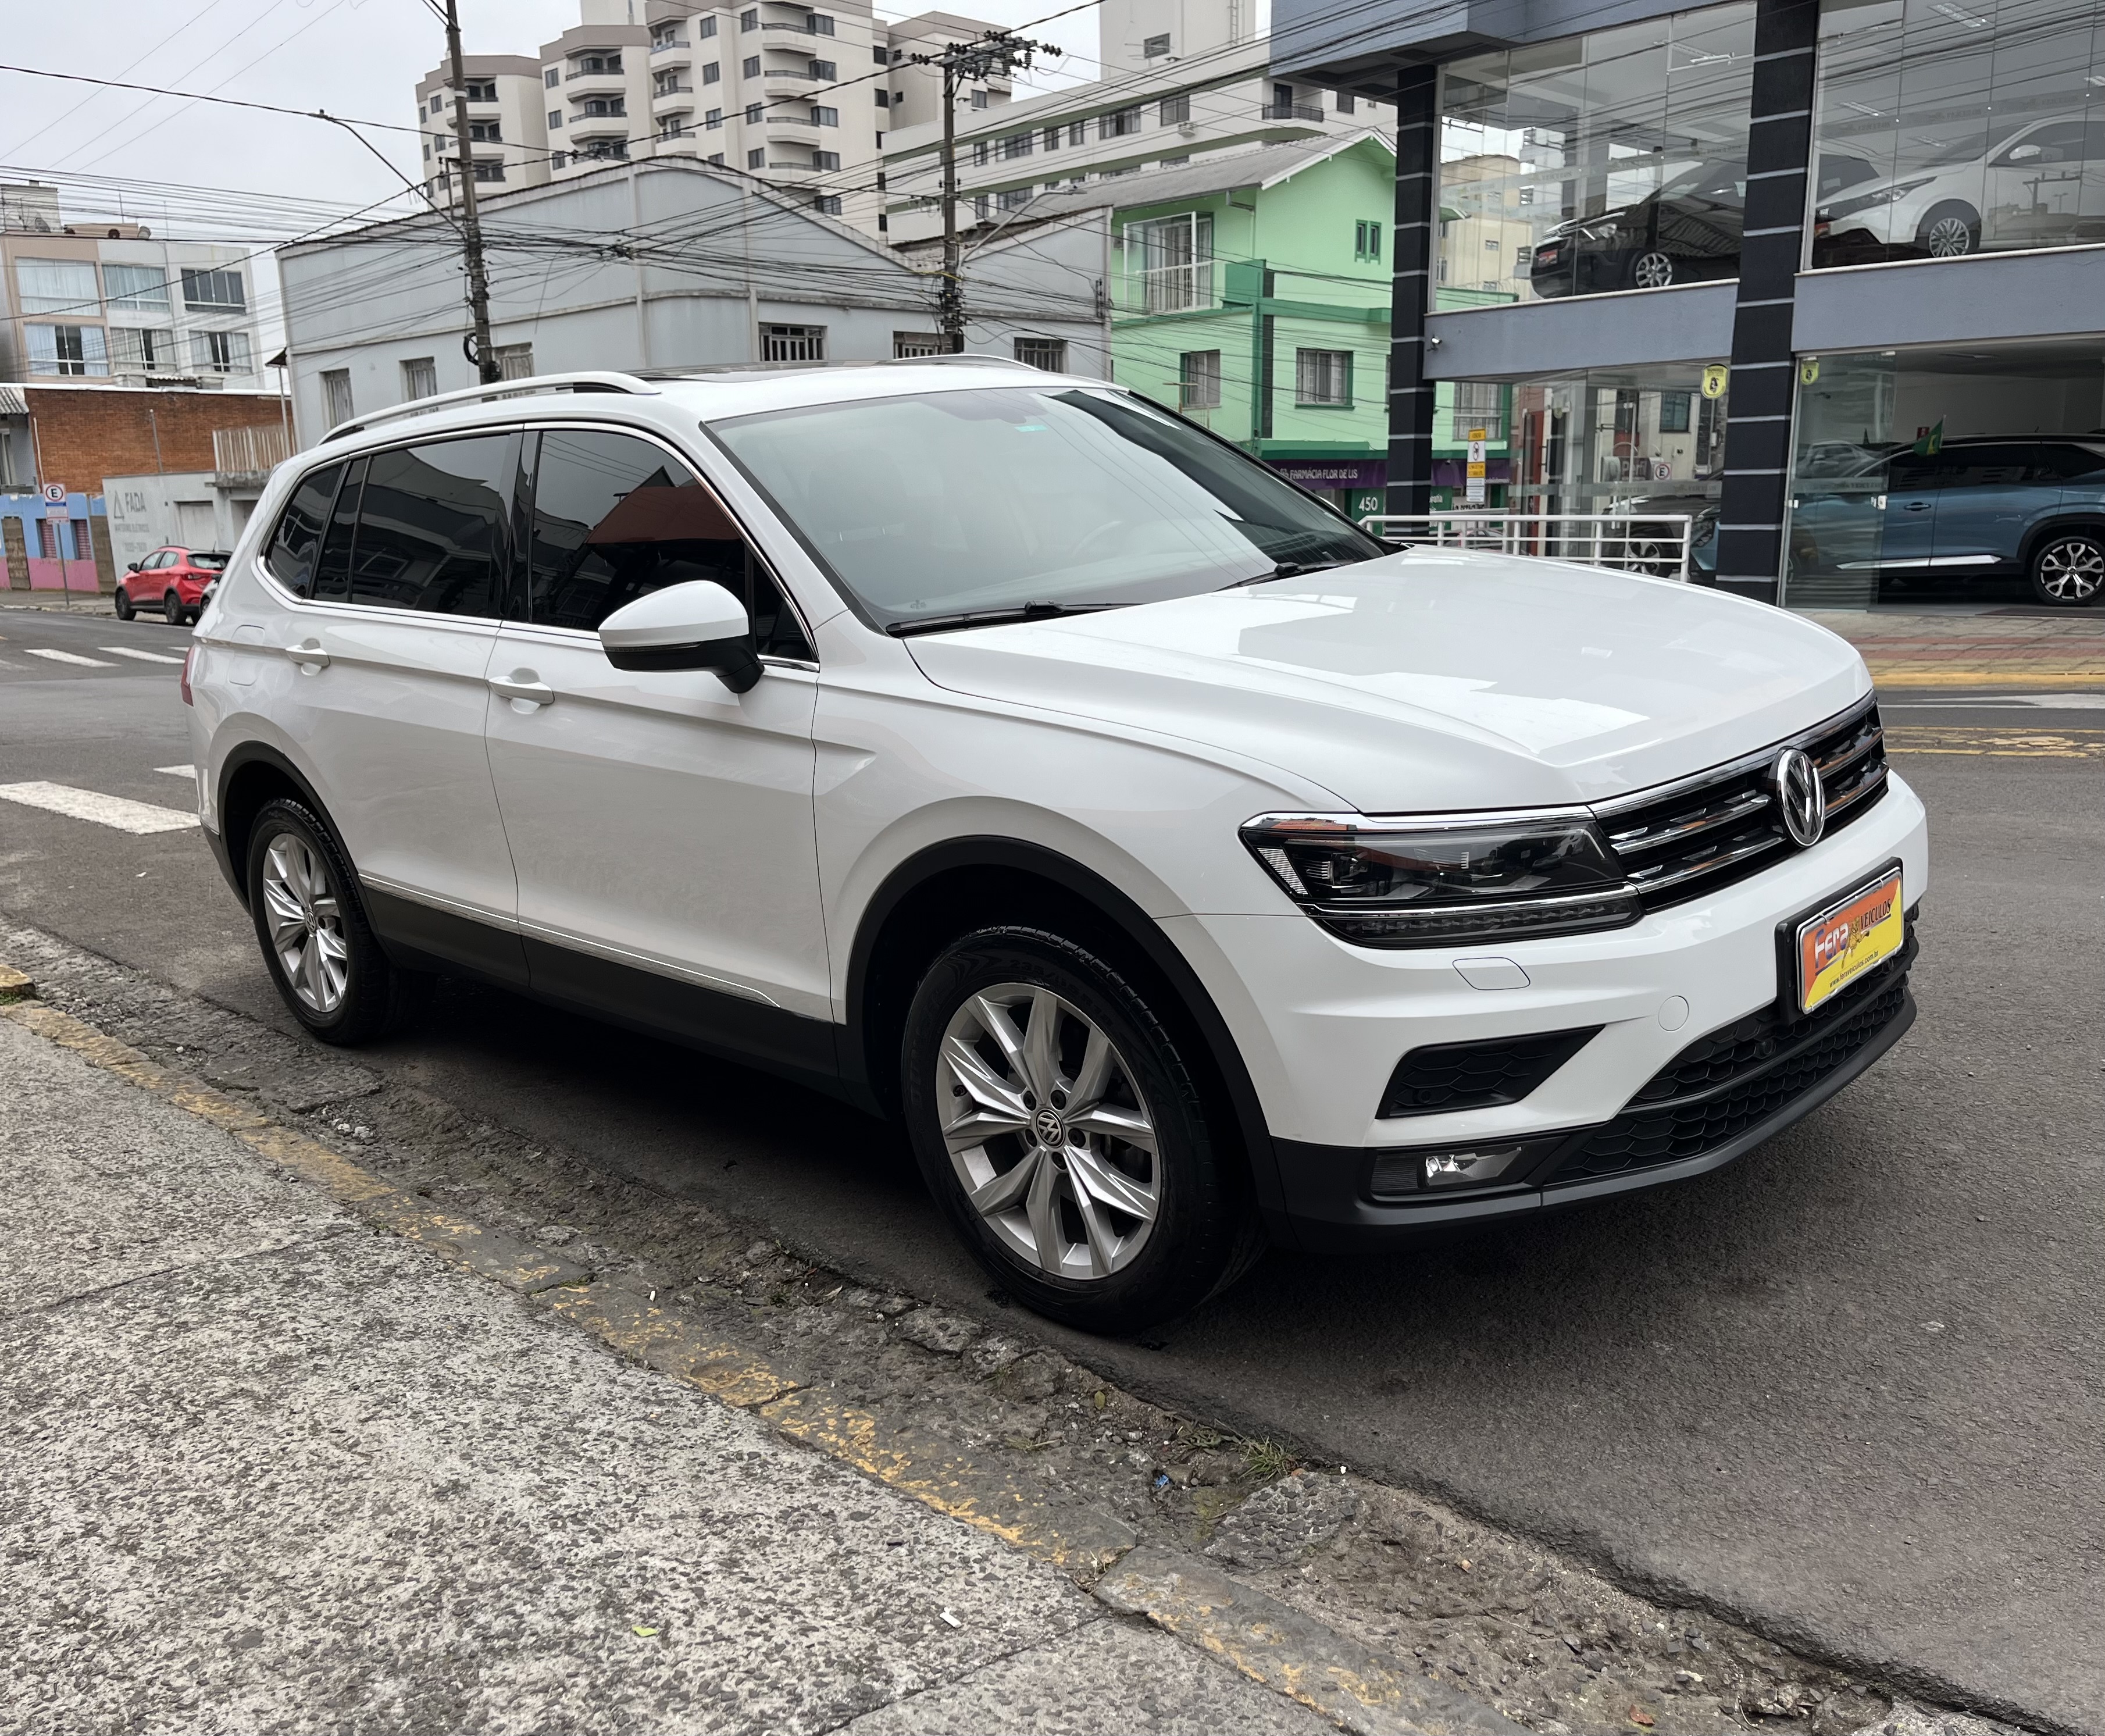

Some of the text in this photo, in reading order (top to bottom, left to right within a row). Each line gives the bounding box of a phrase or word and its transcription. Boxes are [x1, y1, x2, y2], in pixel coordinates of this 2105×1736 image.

[1322, 469, 1338, 479] FLOR
[1339, 469, 1347, 479] DE
[1348, 469, 1358, 479] LIS
[51, 488, 58, 498] E
[124, 492, 147, 512] FADA
[1358, 497, 1378, 512] 450
